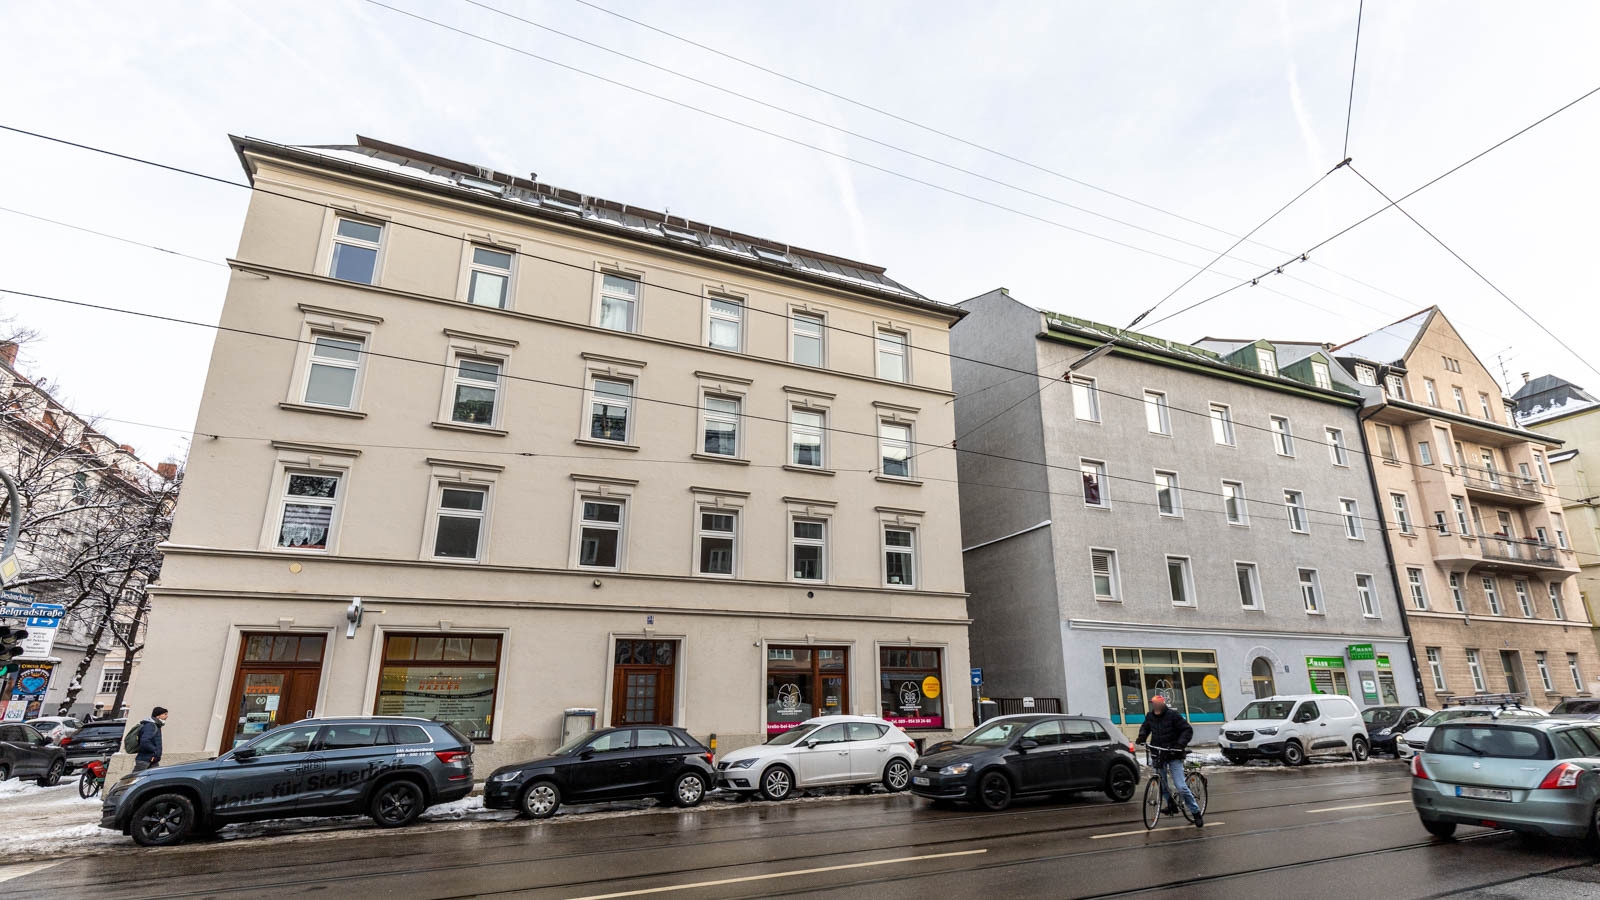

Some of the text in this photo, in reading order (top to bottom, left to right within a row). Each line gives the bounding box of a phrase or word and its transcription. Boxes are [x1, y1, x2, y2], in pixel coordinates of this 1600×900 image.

[0, 607, 63, 617] Belgradstraße
[271, 780, 302, 800] für
[306, 759, 405, 791] Sicherheit
